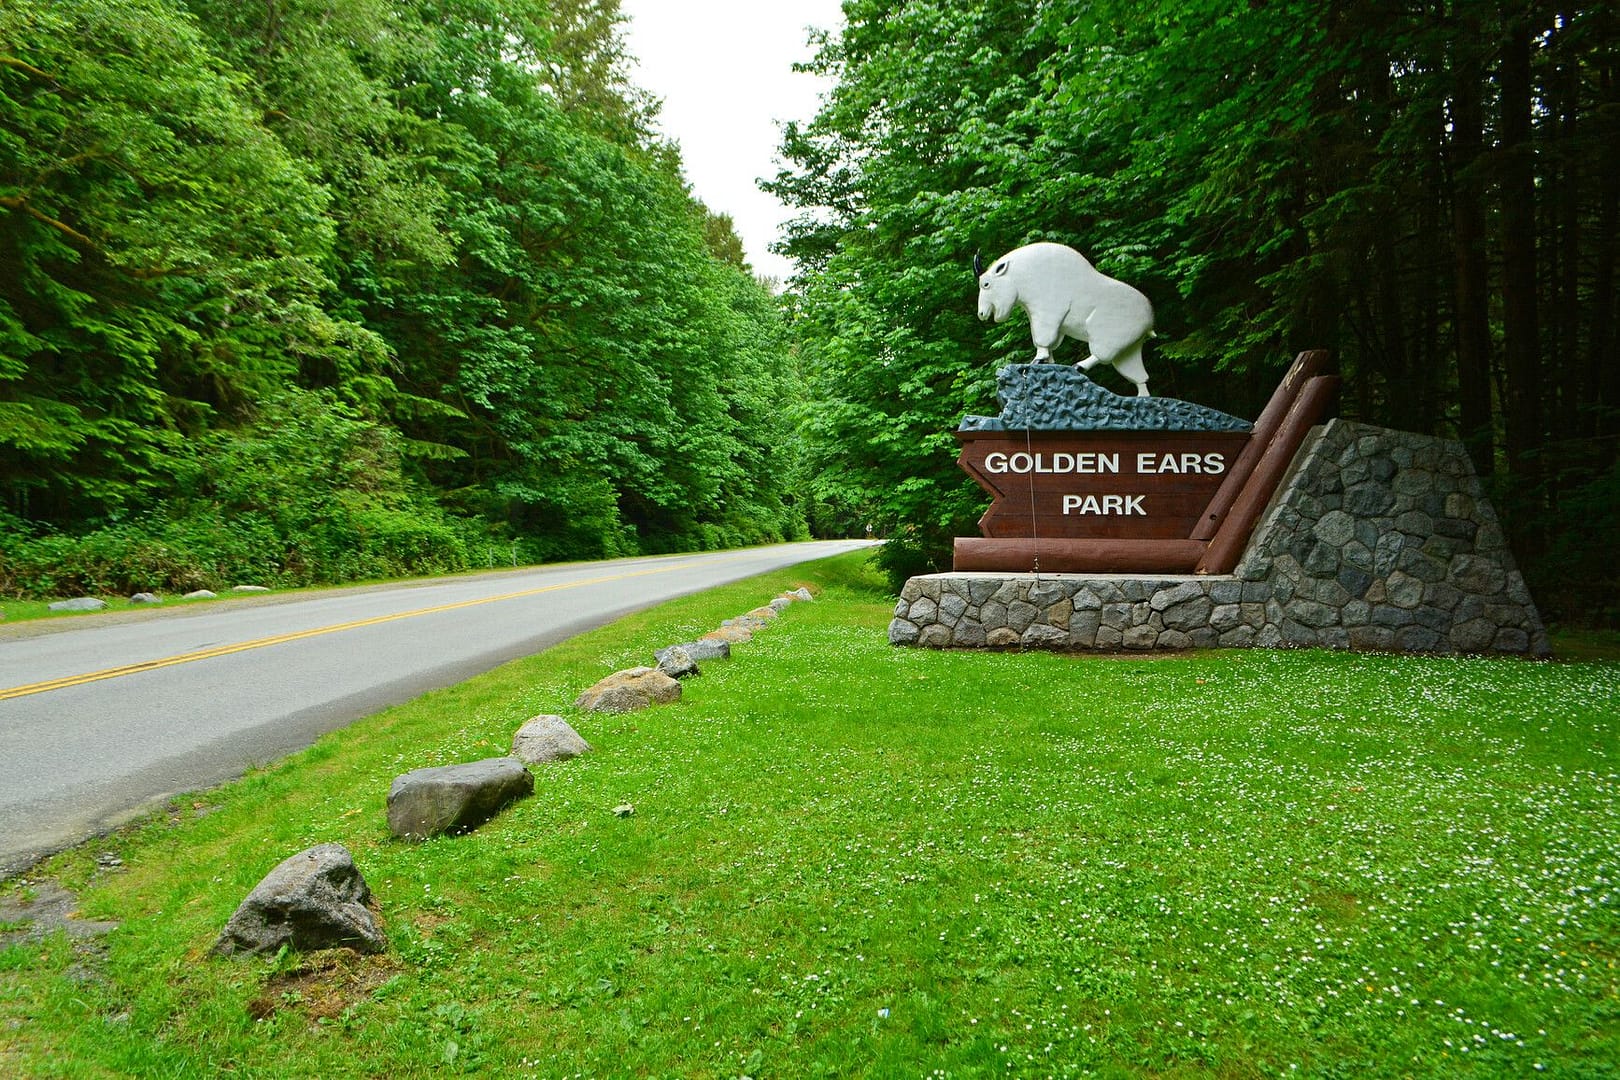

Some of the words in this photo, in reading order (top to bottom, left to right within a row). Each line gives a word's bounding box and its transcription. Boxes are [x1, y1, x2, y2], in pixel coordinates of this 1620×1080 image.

[984, 452, 1119, 474] GOLDEN
[1137, 453, 1225, 474] EARS
[1062, 495, 1147, 516] PARK
